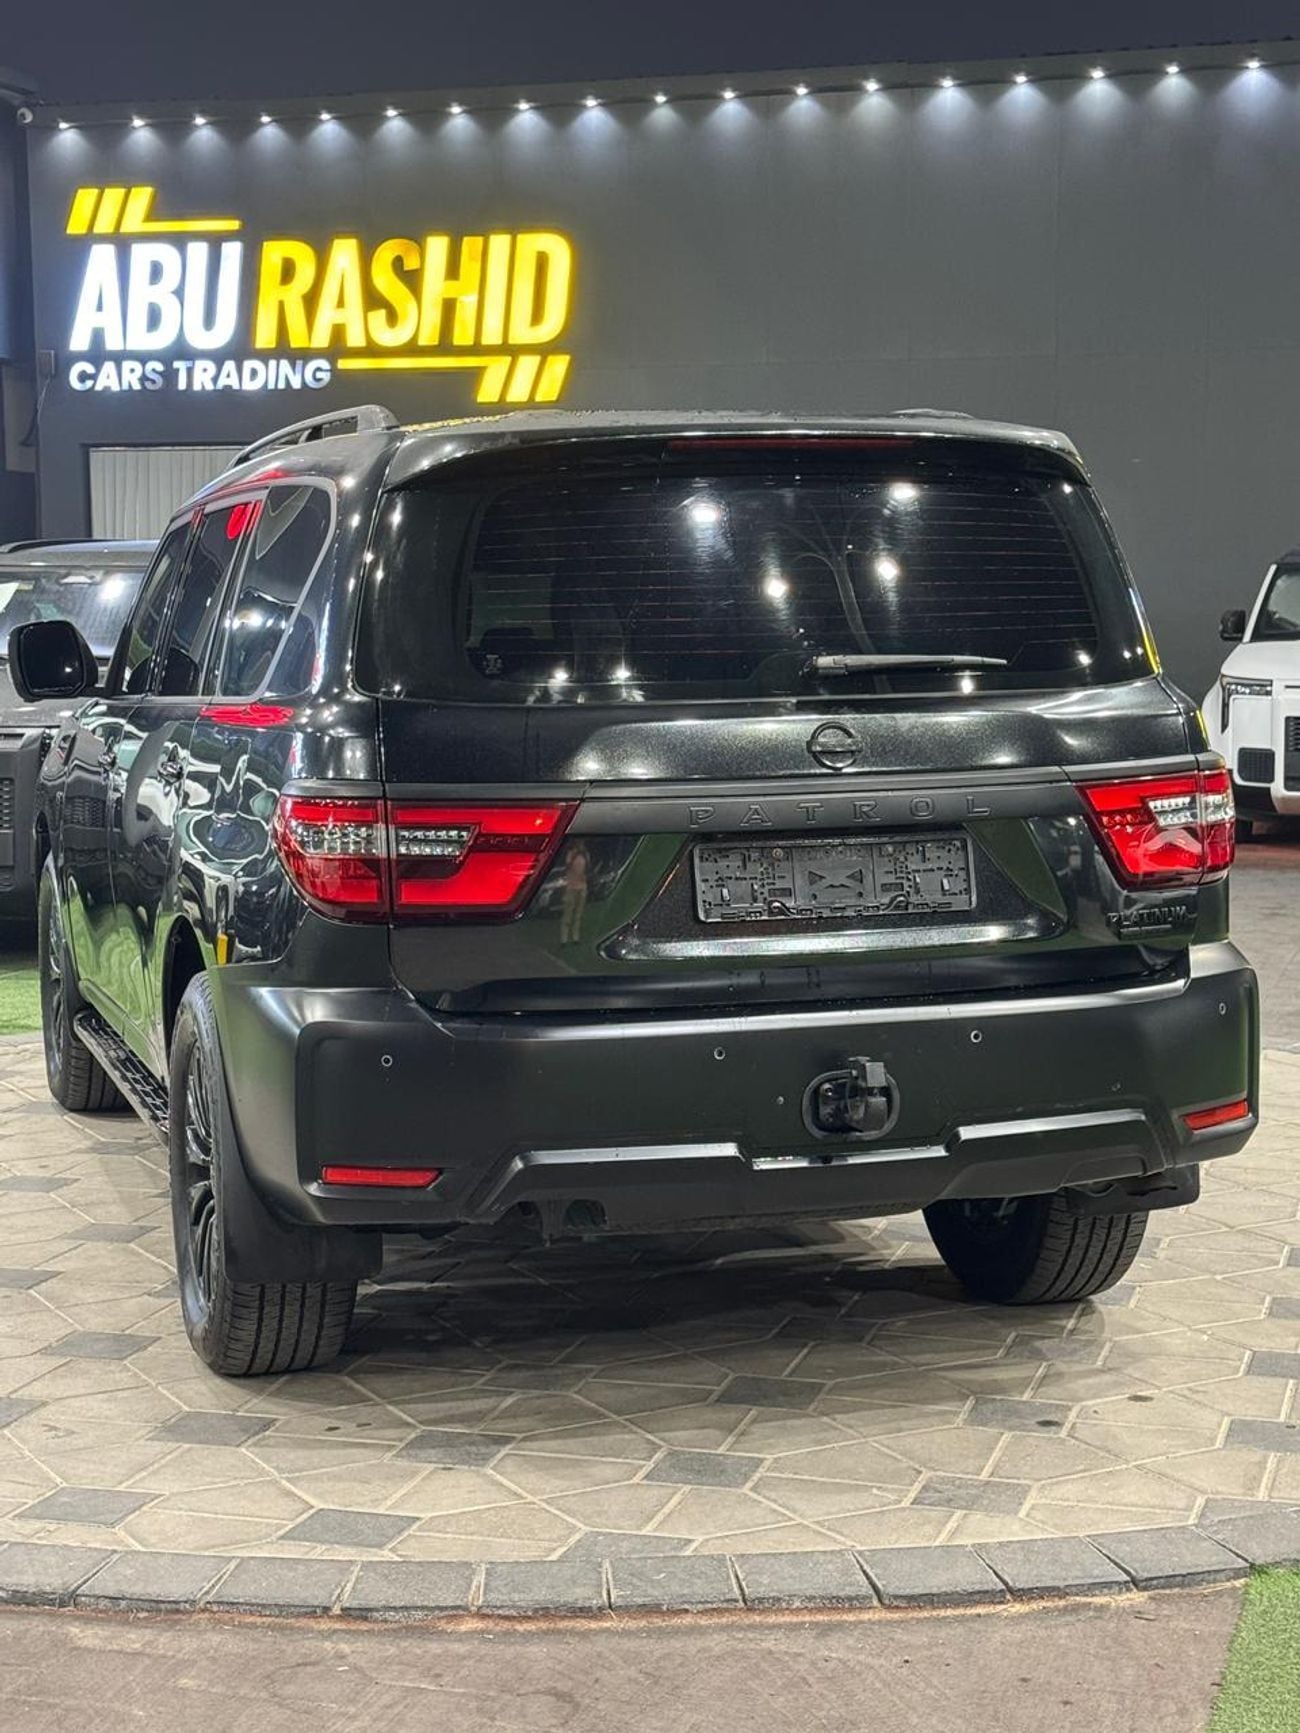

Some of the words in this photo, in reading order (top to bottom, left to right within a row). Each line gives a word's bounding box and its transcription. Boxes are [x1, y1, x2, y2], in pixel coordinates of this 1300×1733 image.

[69, 241, 243, 351] ABU
[254, 232, 572, 349] RASHID
[69, 360, 163, 392] CARS
[173, 358, 332, 391] TRADING
[688, 795, 992, 828] PATROL
